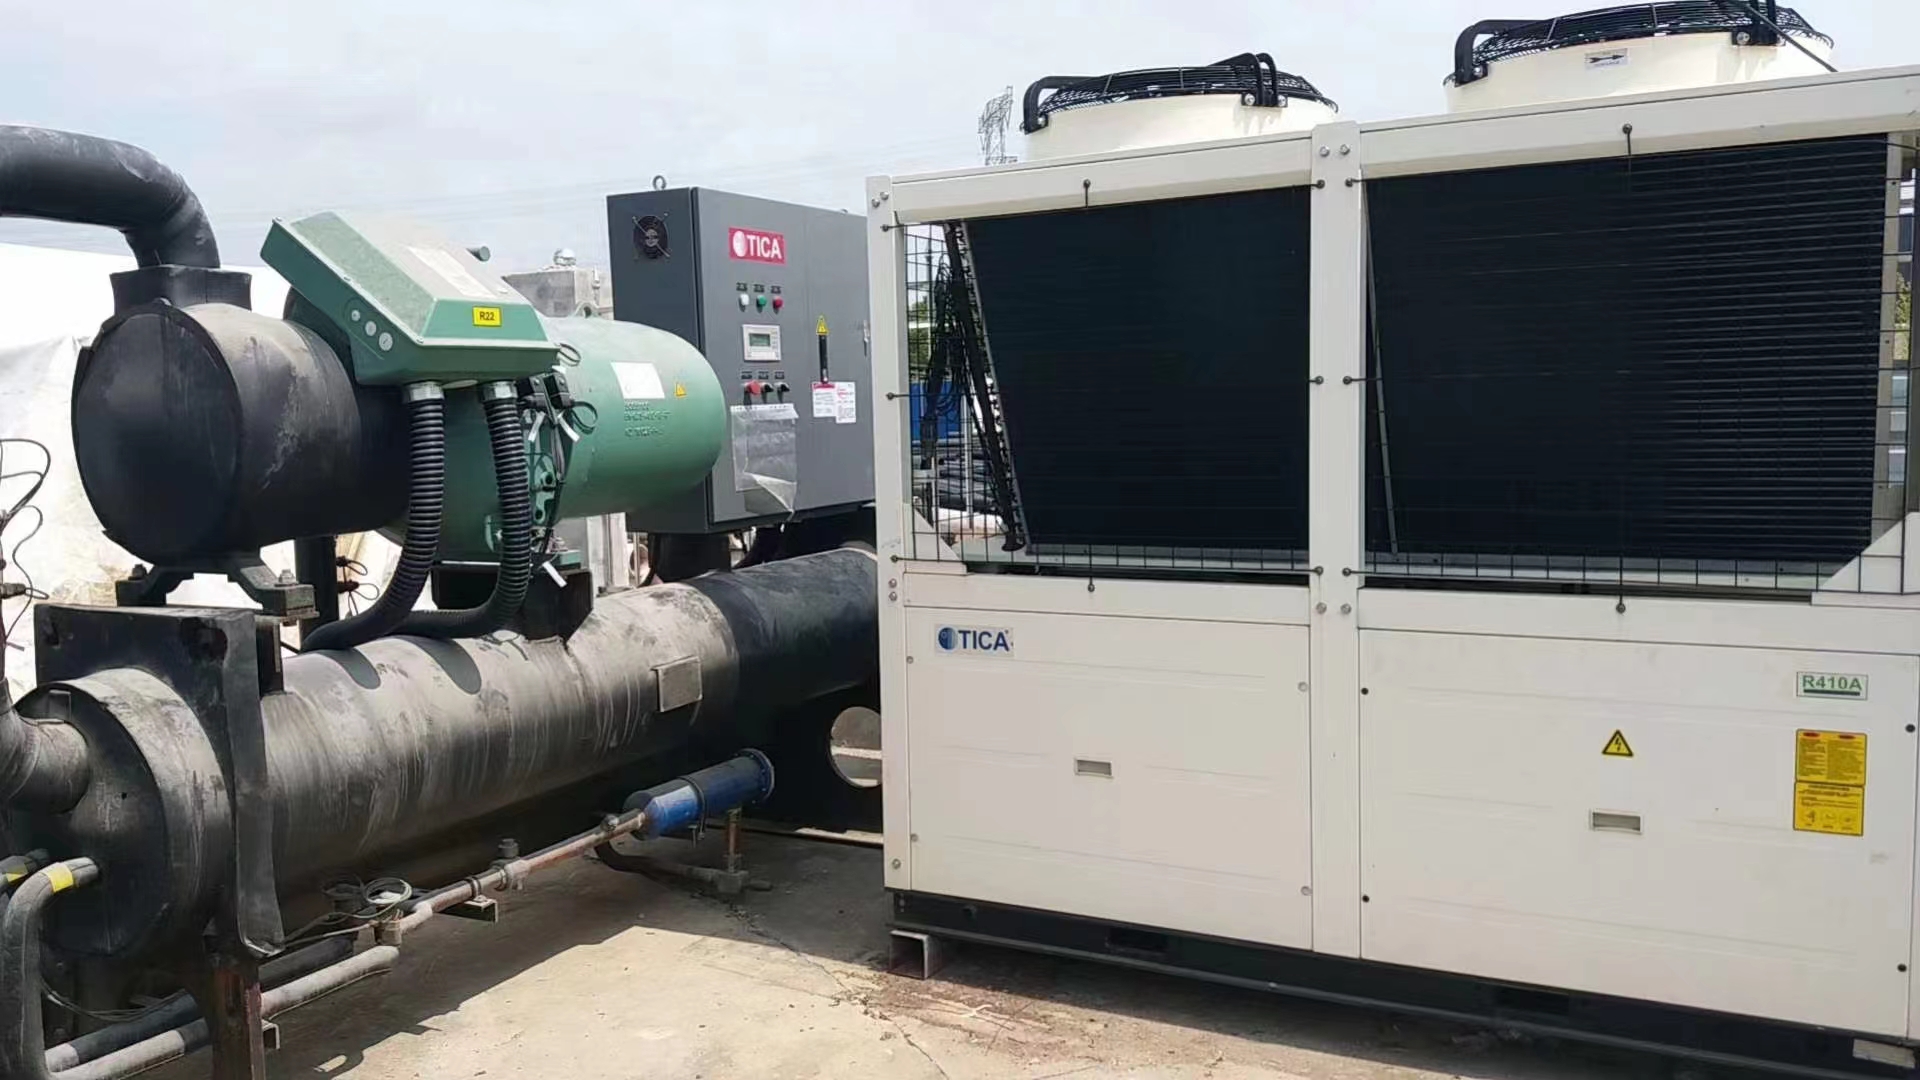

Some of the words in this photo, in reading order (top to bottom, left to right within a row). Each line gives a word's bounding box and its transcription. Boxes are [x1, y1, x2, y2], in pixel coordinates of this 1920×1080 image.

[746, 234, 782, 259] TICA
[479, 311, 495, 321] R22
[957, 629, 1010, 652] TICA
[1802, 674, 1862, 691] R410A
